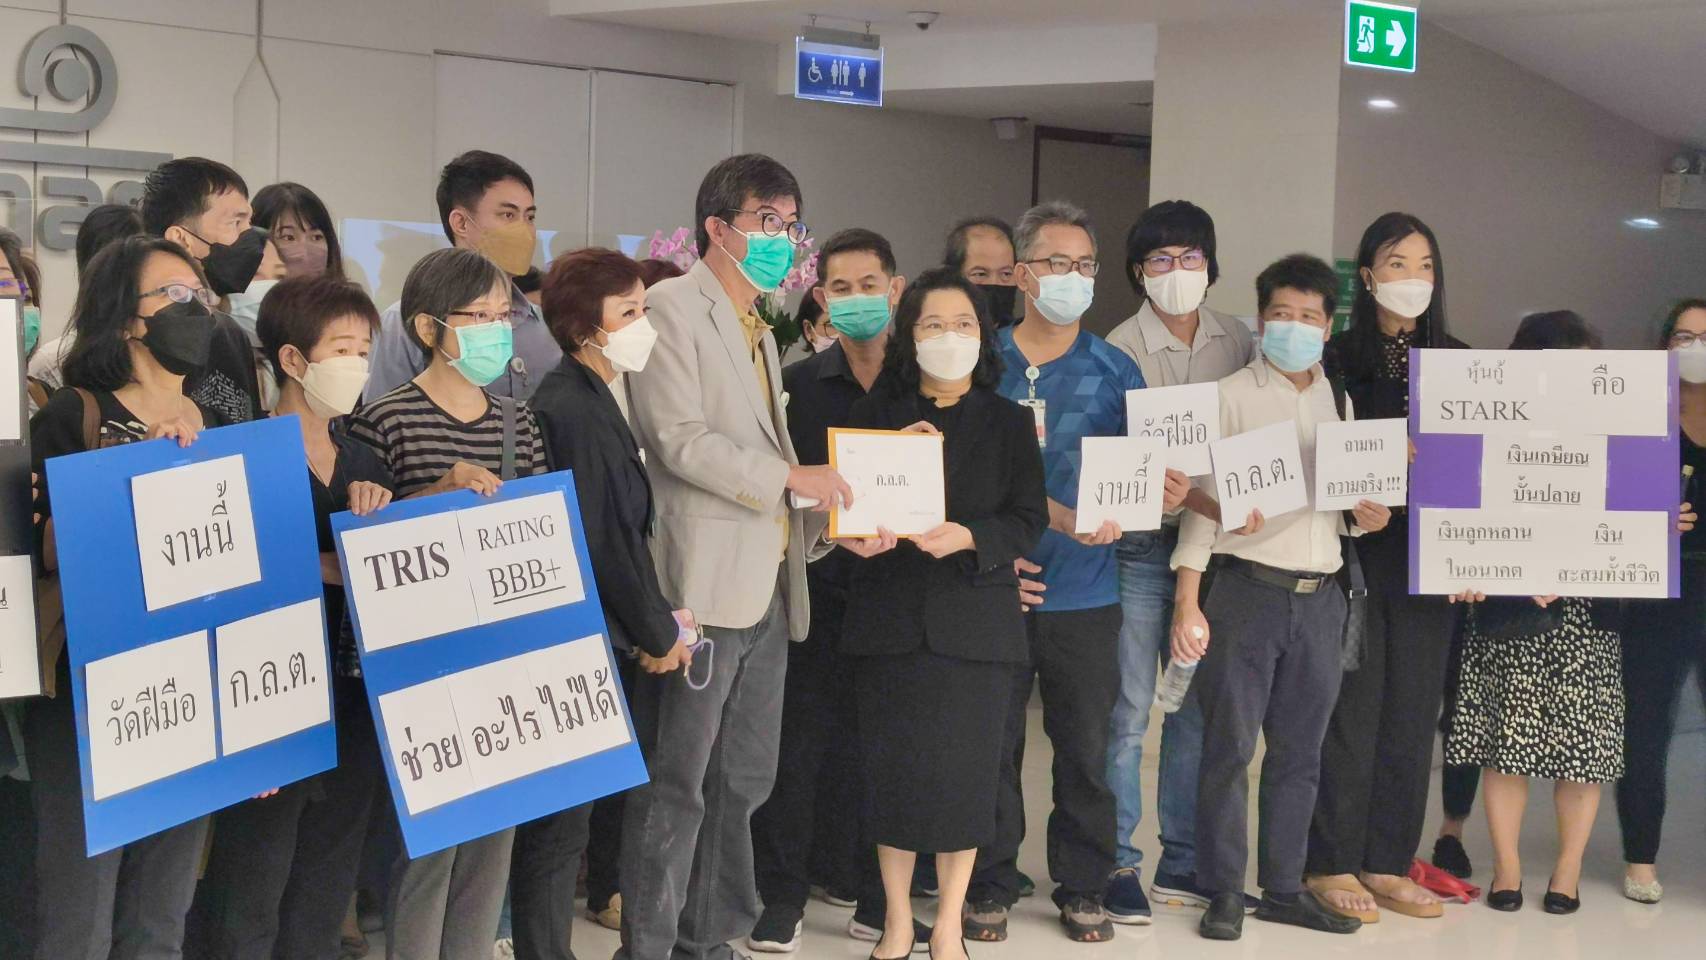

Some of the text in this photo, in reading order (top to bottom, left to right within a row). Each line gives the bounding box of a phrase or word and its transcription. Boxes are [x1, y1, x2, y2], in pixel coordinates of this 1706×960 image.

[1468, 359, 1506, 385] หุ้นกู้
[1591, 363, 1625, 396] คือ
[1440, 400, 1530, 421] STARK
[1507, 444, 1589, 465] เงินเกษียณ
[1095, 452, 1152, 506] งานนี้
[1225, 457, 1294, 499] ก.ล.ต.
[1327, 473, 1382, 495] ความจริง
[1513, 475, 1581, 503] บั้นปลาย
[161, 480, 235, 567] งานนี้
[477, 514, 555, 552] RATING
[1438, 520, 1532, 545] เงินลูกหลาน
[1595, 523, 1624, 543] เงิน
[364, 542, 450, 592] TRIS
[487, 557, 562, 599] BBB+
[1446, 558, 1522, 578] ในอนาคต
[230, 651, 317, 708] ก.ล.ต.
[106, 677, 197, 746] วัดฝีมือ
